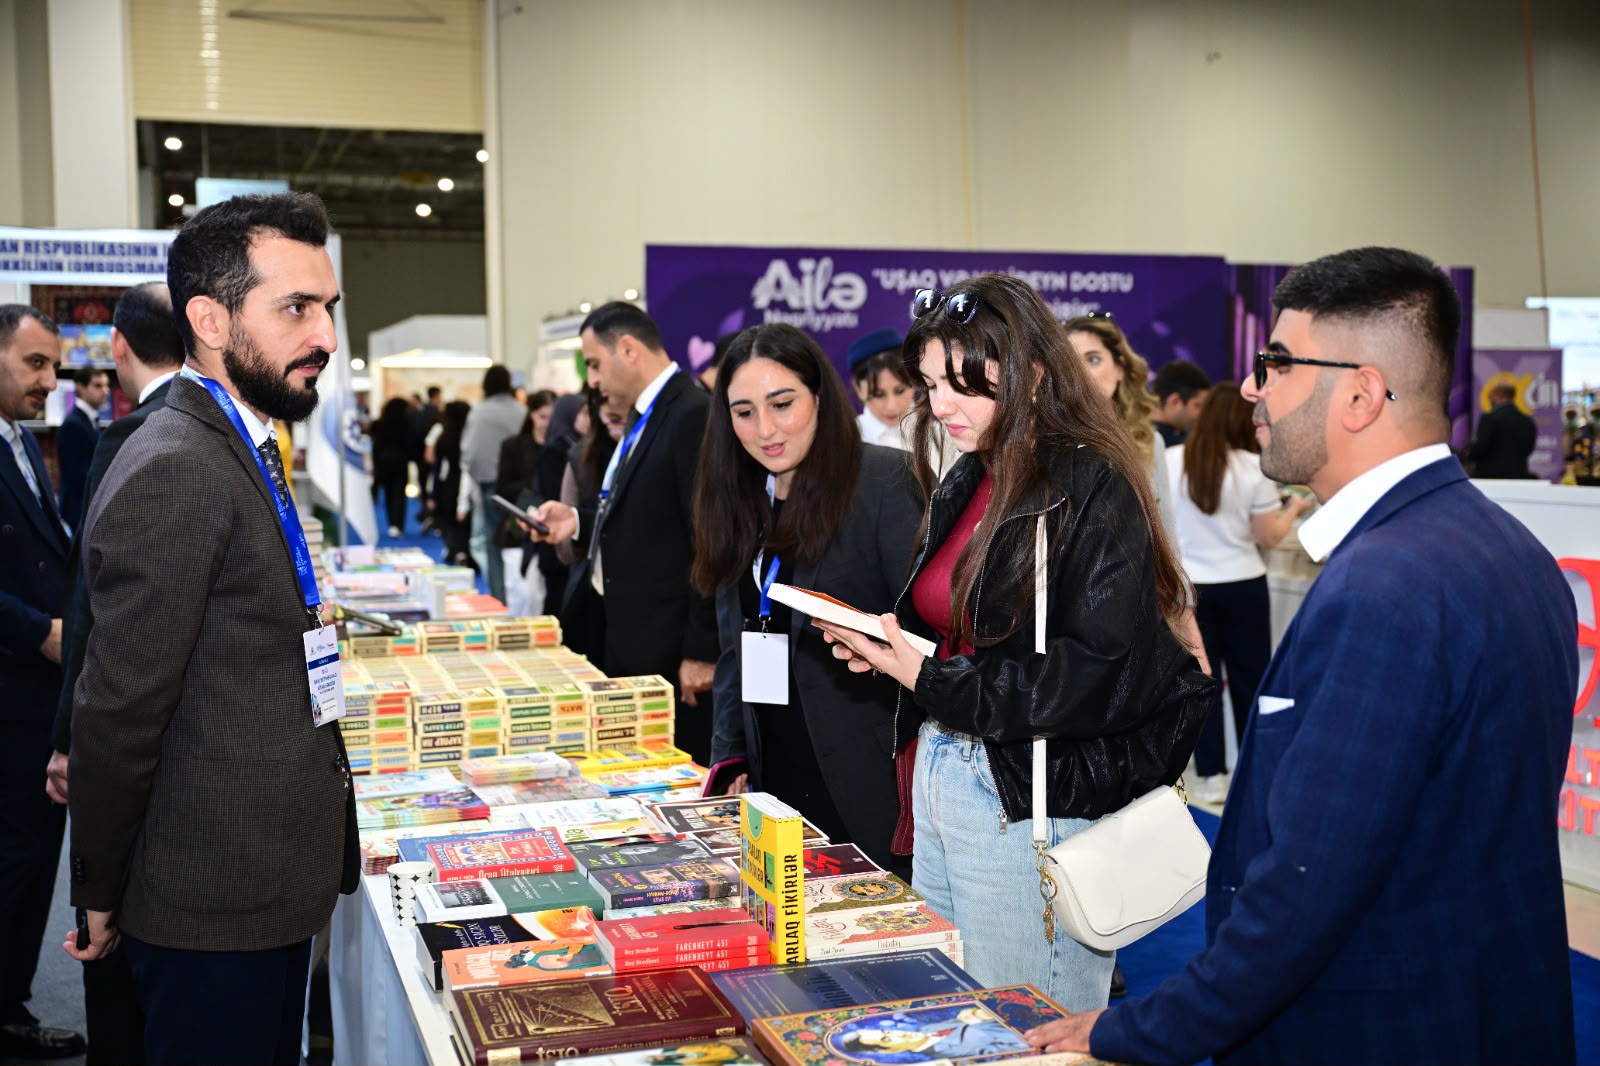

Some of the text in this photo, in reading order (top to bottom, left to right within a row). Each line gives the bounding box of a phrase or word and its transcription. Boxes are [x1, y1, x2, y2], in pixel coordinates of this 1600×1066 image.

[752, 257, 867, 310] Ailə
[1070, 271, 1134, 293] DOSTU
[781, 854, 799, 916] FİKİRLƏR
[675, 939, 714, 952] FARENHEYT
[716, 939, 728, 948] 451
[675, 951, 714, 963] FARENHEYT
[716, 950, 728, 959] 451
[717, 960, 730, 969] 451
